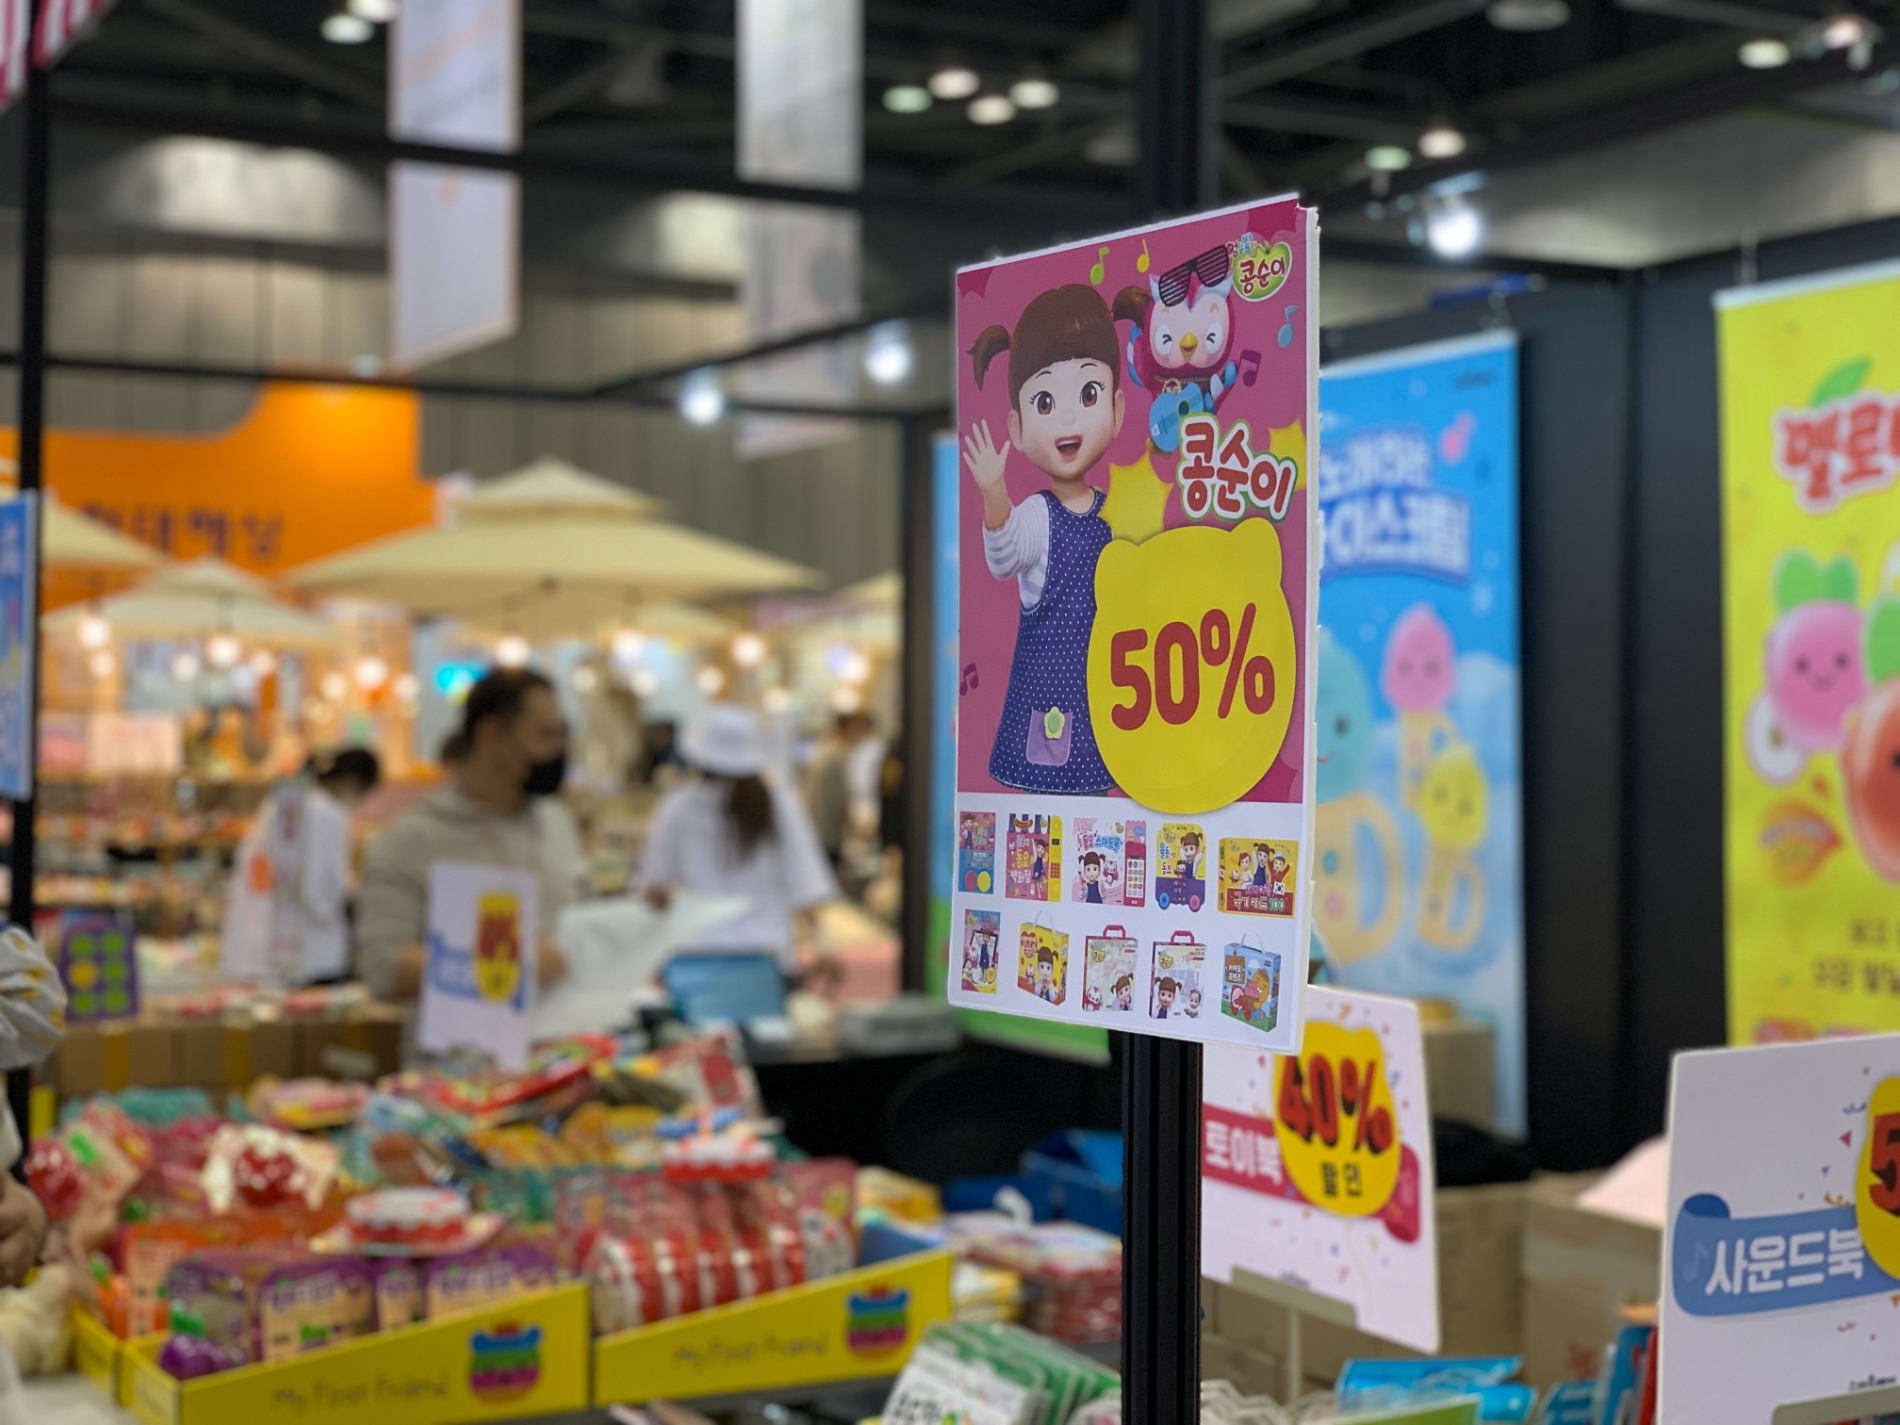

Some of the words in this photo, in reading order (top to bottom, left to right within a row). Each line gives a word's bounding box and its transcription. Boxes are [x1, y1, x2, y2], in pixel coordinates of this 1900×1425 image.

[1239, 256, 1286, 295] 콩순이
[1181, 418, 1294, 516] 콩순이
[1110, 602, 1275, 731] 50%
[1268, 897, 1286, 912] 100
[1278, 1053, 1394, 1155] 40%
[1204, 1119, 1283, 1186] 토이북
[1703, 1228, 1866, 1297] 사운드북
